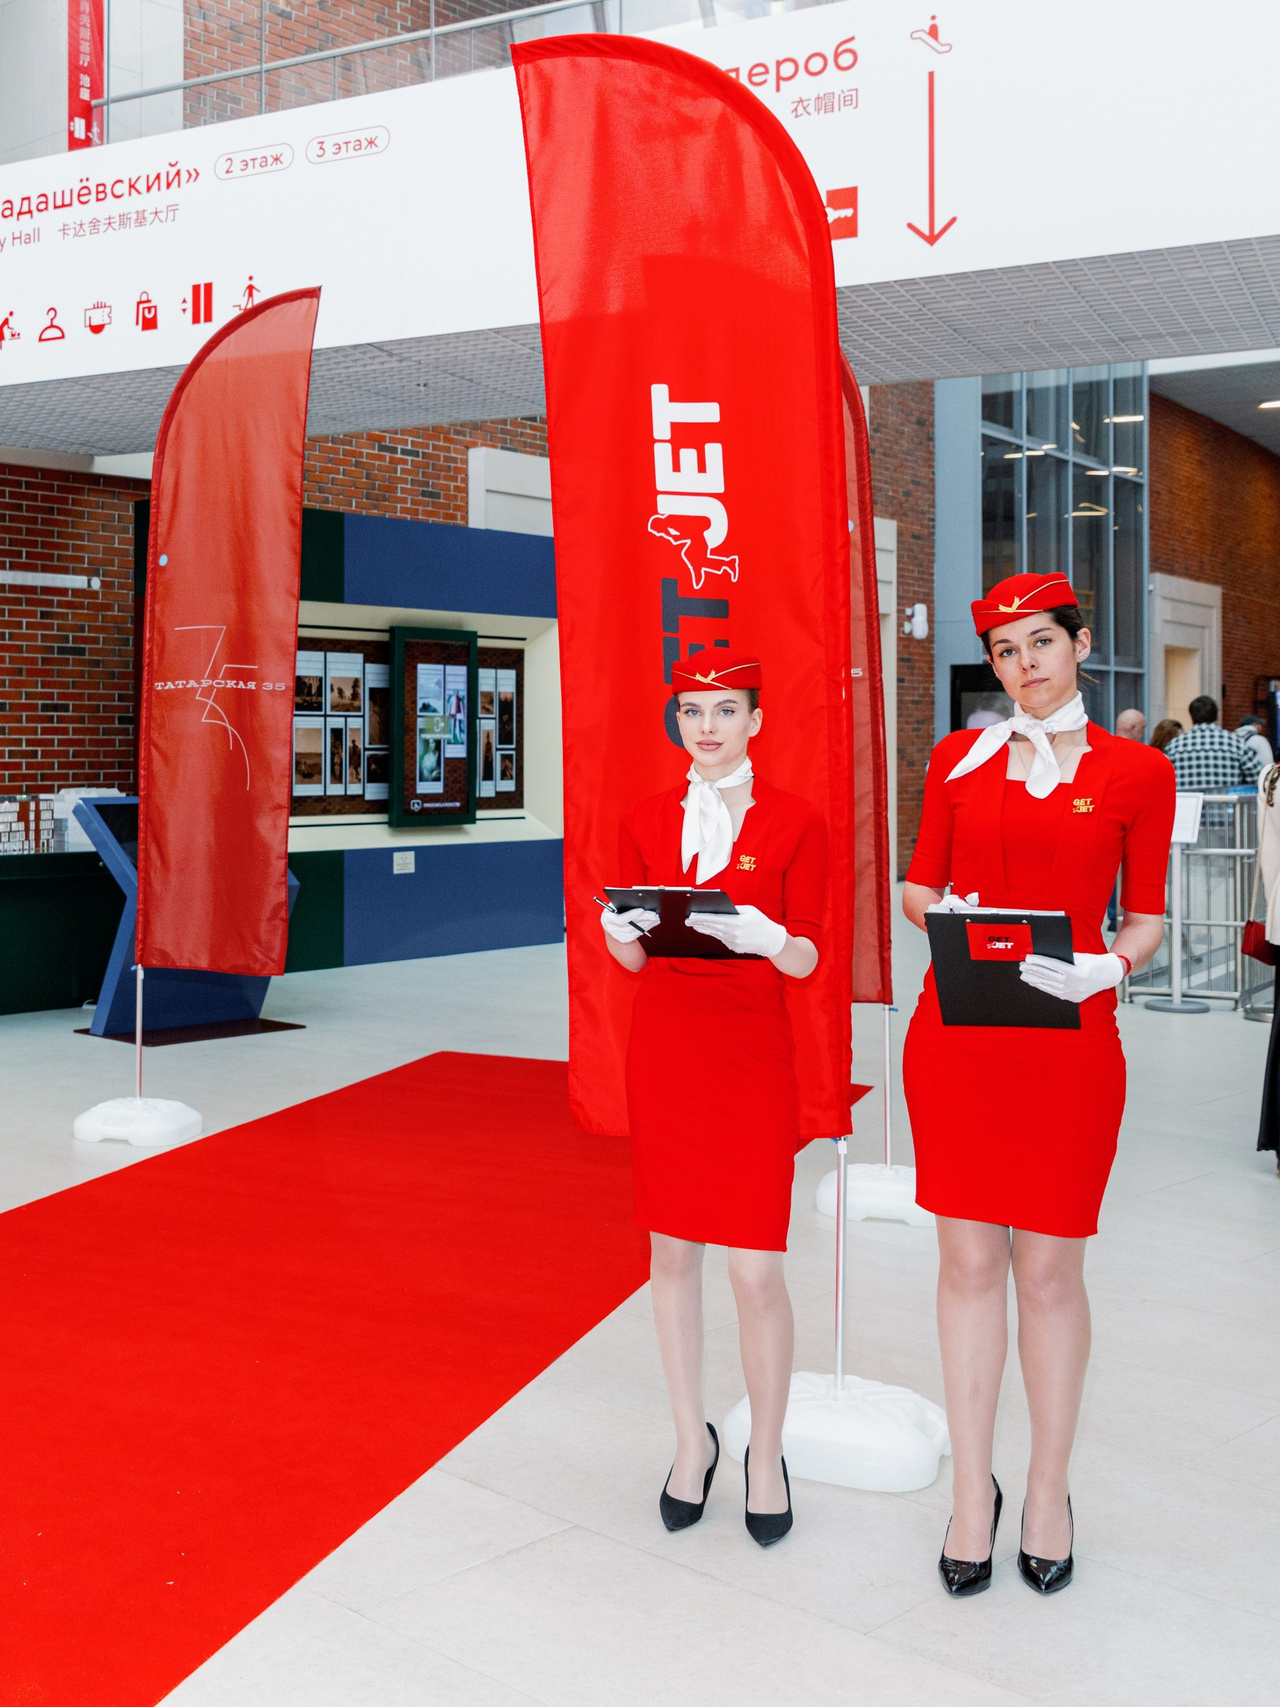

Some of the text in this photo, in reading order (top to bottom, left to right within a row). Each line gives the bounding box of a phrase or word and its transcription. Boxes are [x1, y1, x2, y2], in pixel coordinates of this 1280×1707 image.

[724, 35, 858, 93] ероб
[790, 88, 859, 119] 衣帽间
[315, 135, 379, 158] 3 этаж
[224, 152, 284, 174] 2 этаж
[57, 203, 180, 240] 卡达舍夫斯基大厅
[11, 227, 41, 247] Hall
[650, 383, 729, 550] JET
[154, 679, 286, 691] ТАТАРСКАЯ 35
[1073, 798, 1093, 806] GET
[1076, 805, 1095, 813] JET
[740, 854, 756, 864] GET
[740, 863, 756, 871] JET
[991, 941, 1014, 949] JET
